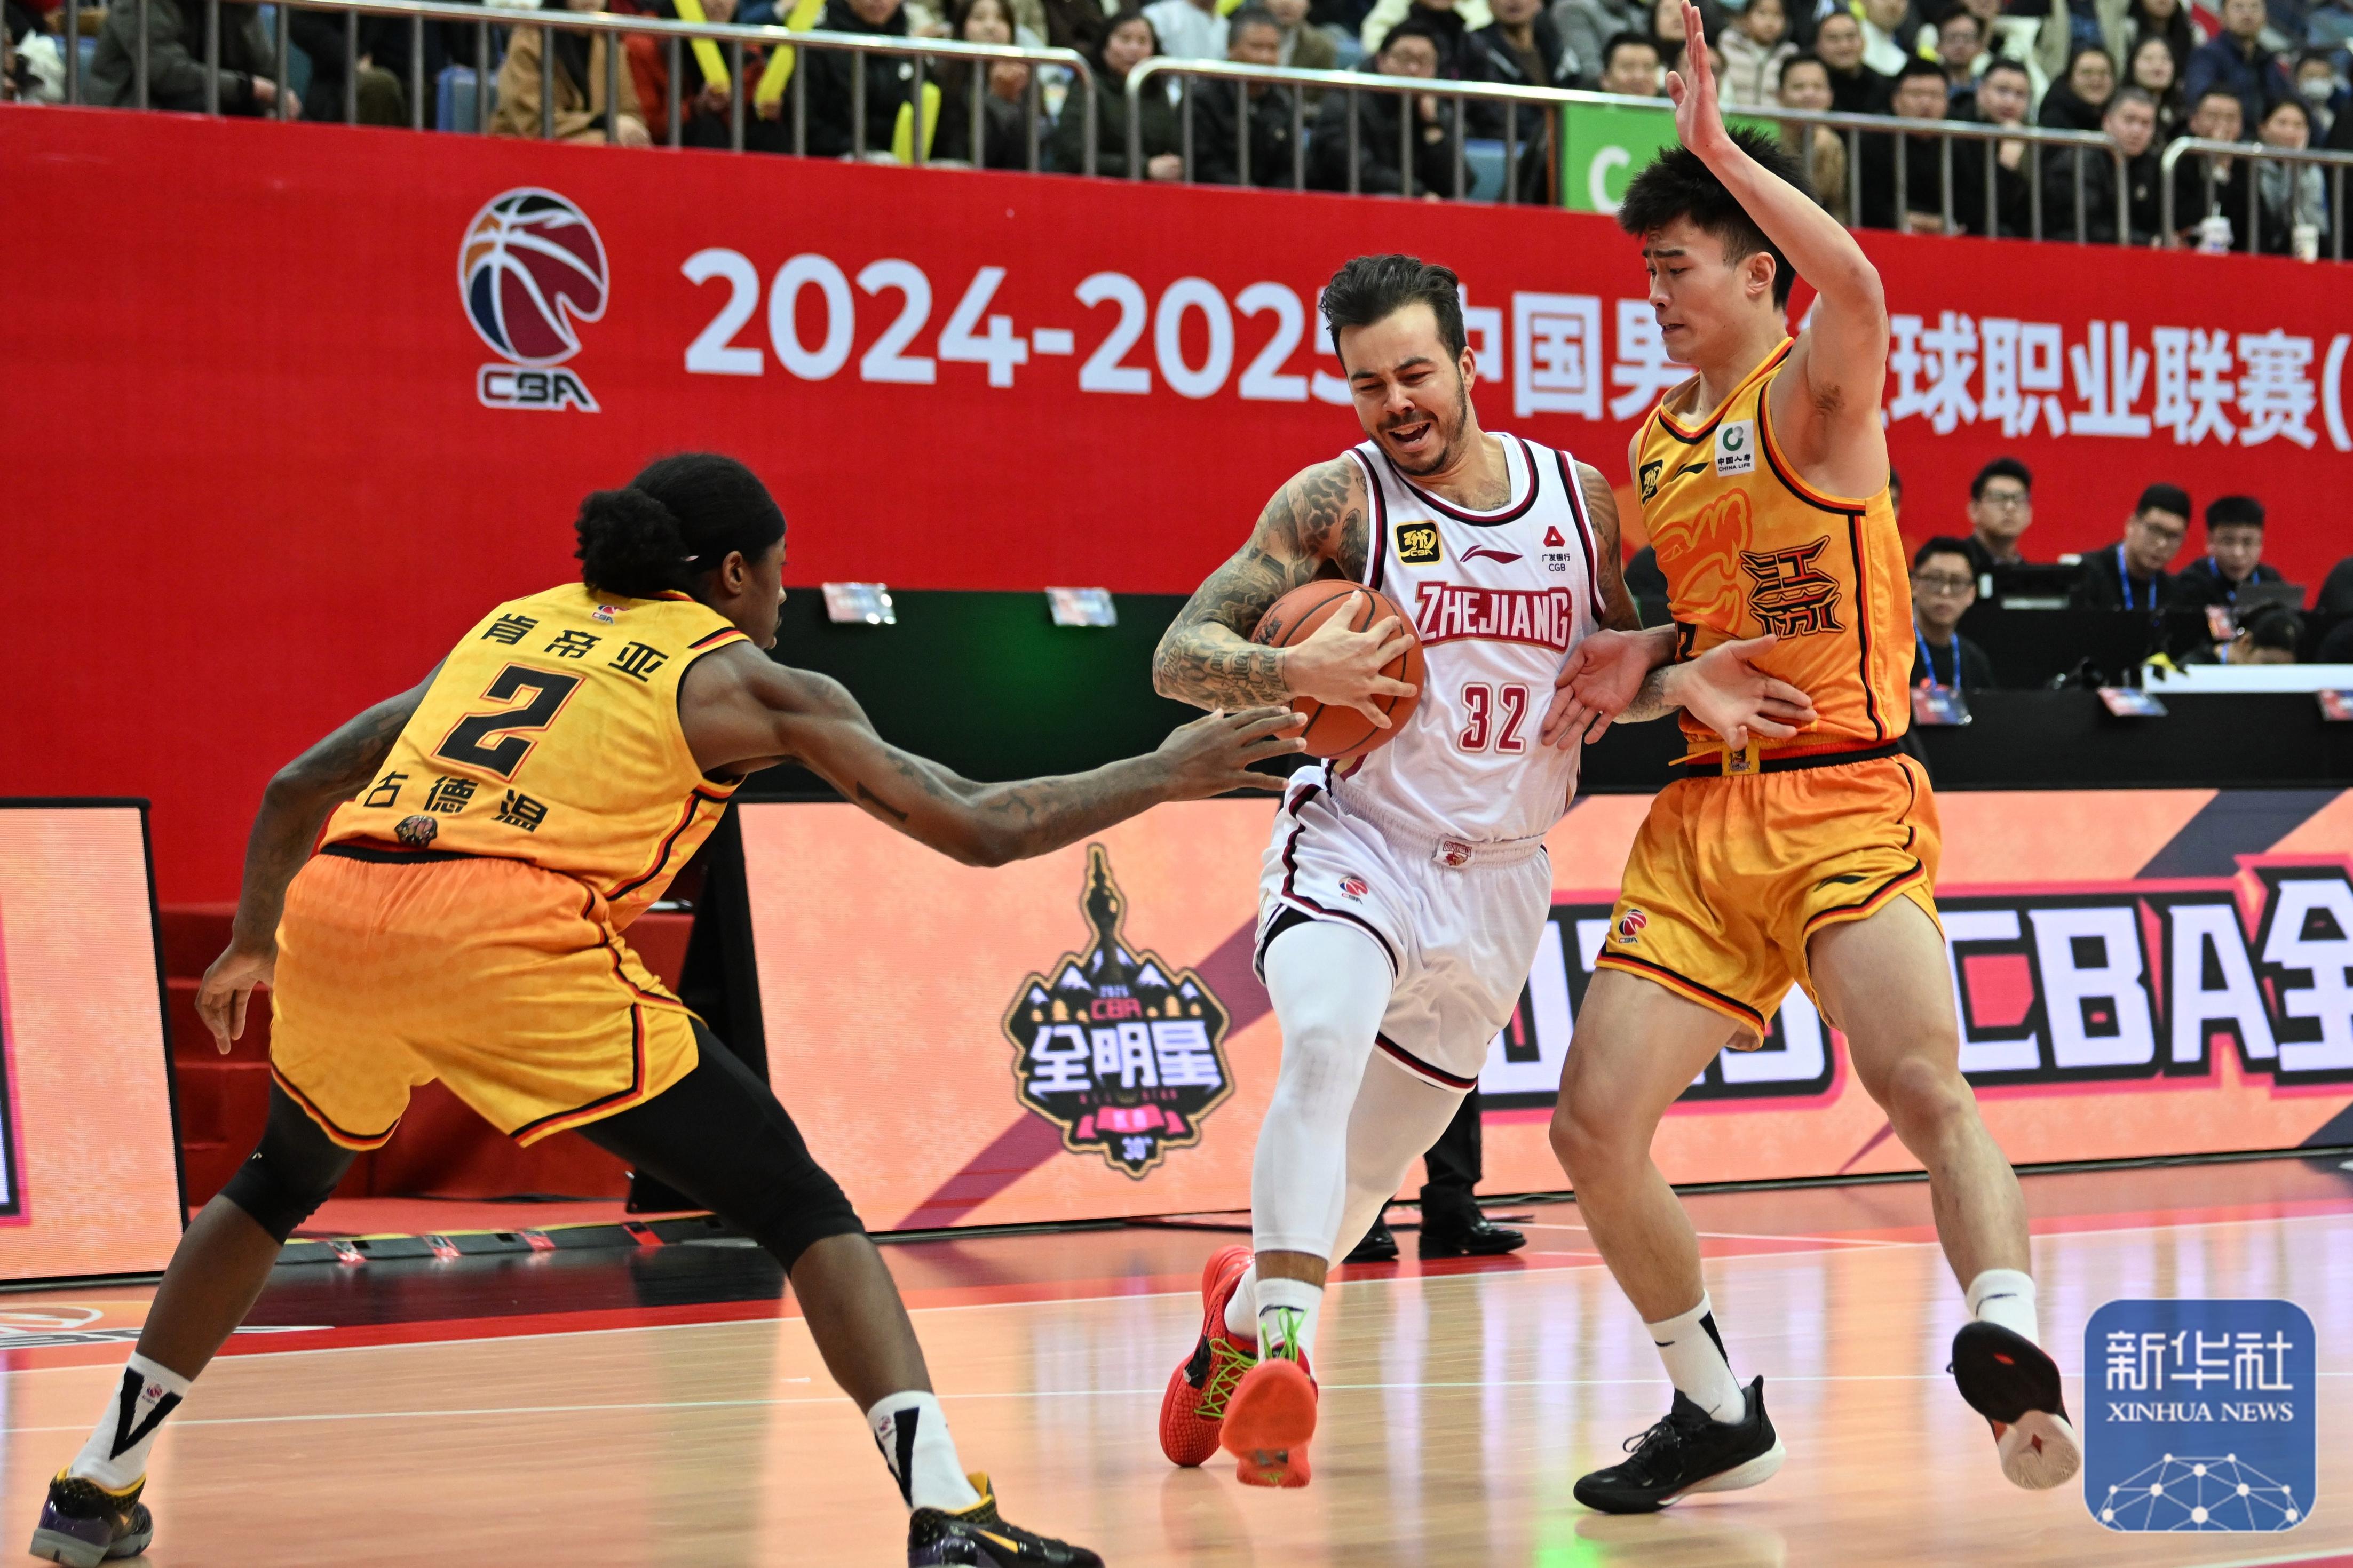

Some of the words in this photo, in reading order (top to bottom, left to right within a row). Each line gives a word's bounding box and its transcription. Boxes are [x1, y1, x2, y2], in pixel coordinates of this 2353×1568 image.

[479, 364, 601, 412] CBA
[1717, 453, 1750, 466] 中国人寿
[1410, 549, 1434, 557] CBA
[1542, 553, 1571, 562] 广发银行
[1548, 563, 1566, 572] CGB
[1417, 584, 1571, 649] ZHEJIANG
[480, 612, 669, 683] 肯帝亚
[430, 661, 587, 783] 2
[1457, 682, 1530, 755] 32
[1091, 998, 1143, 1020] CBA
[1028, 1020, 1223, 1095] 全明星
